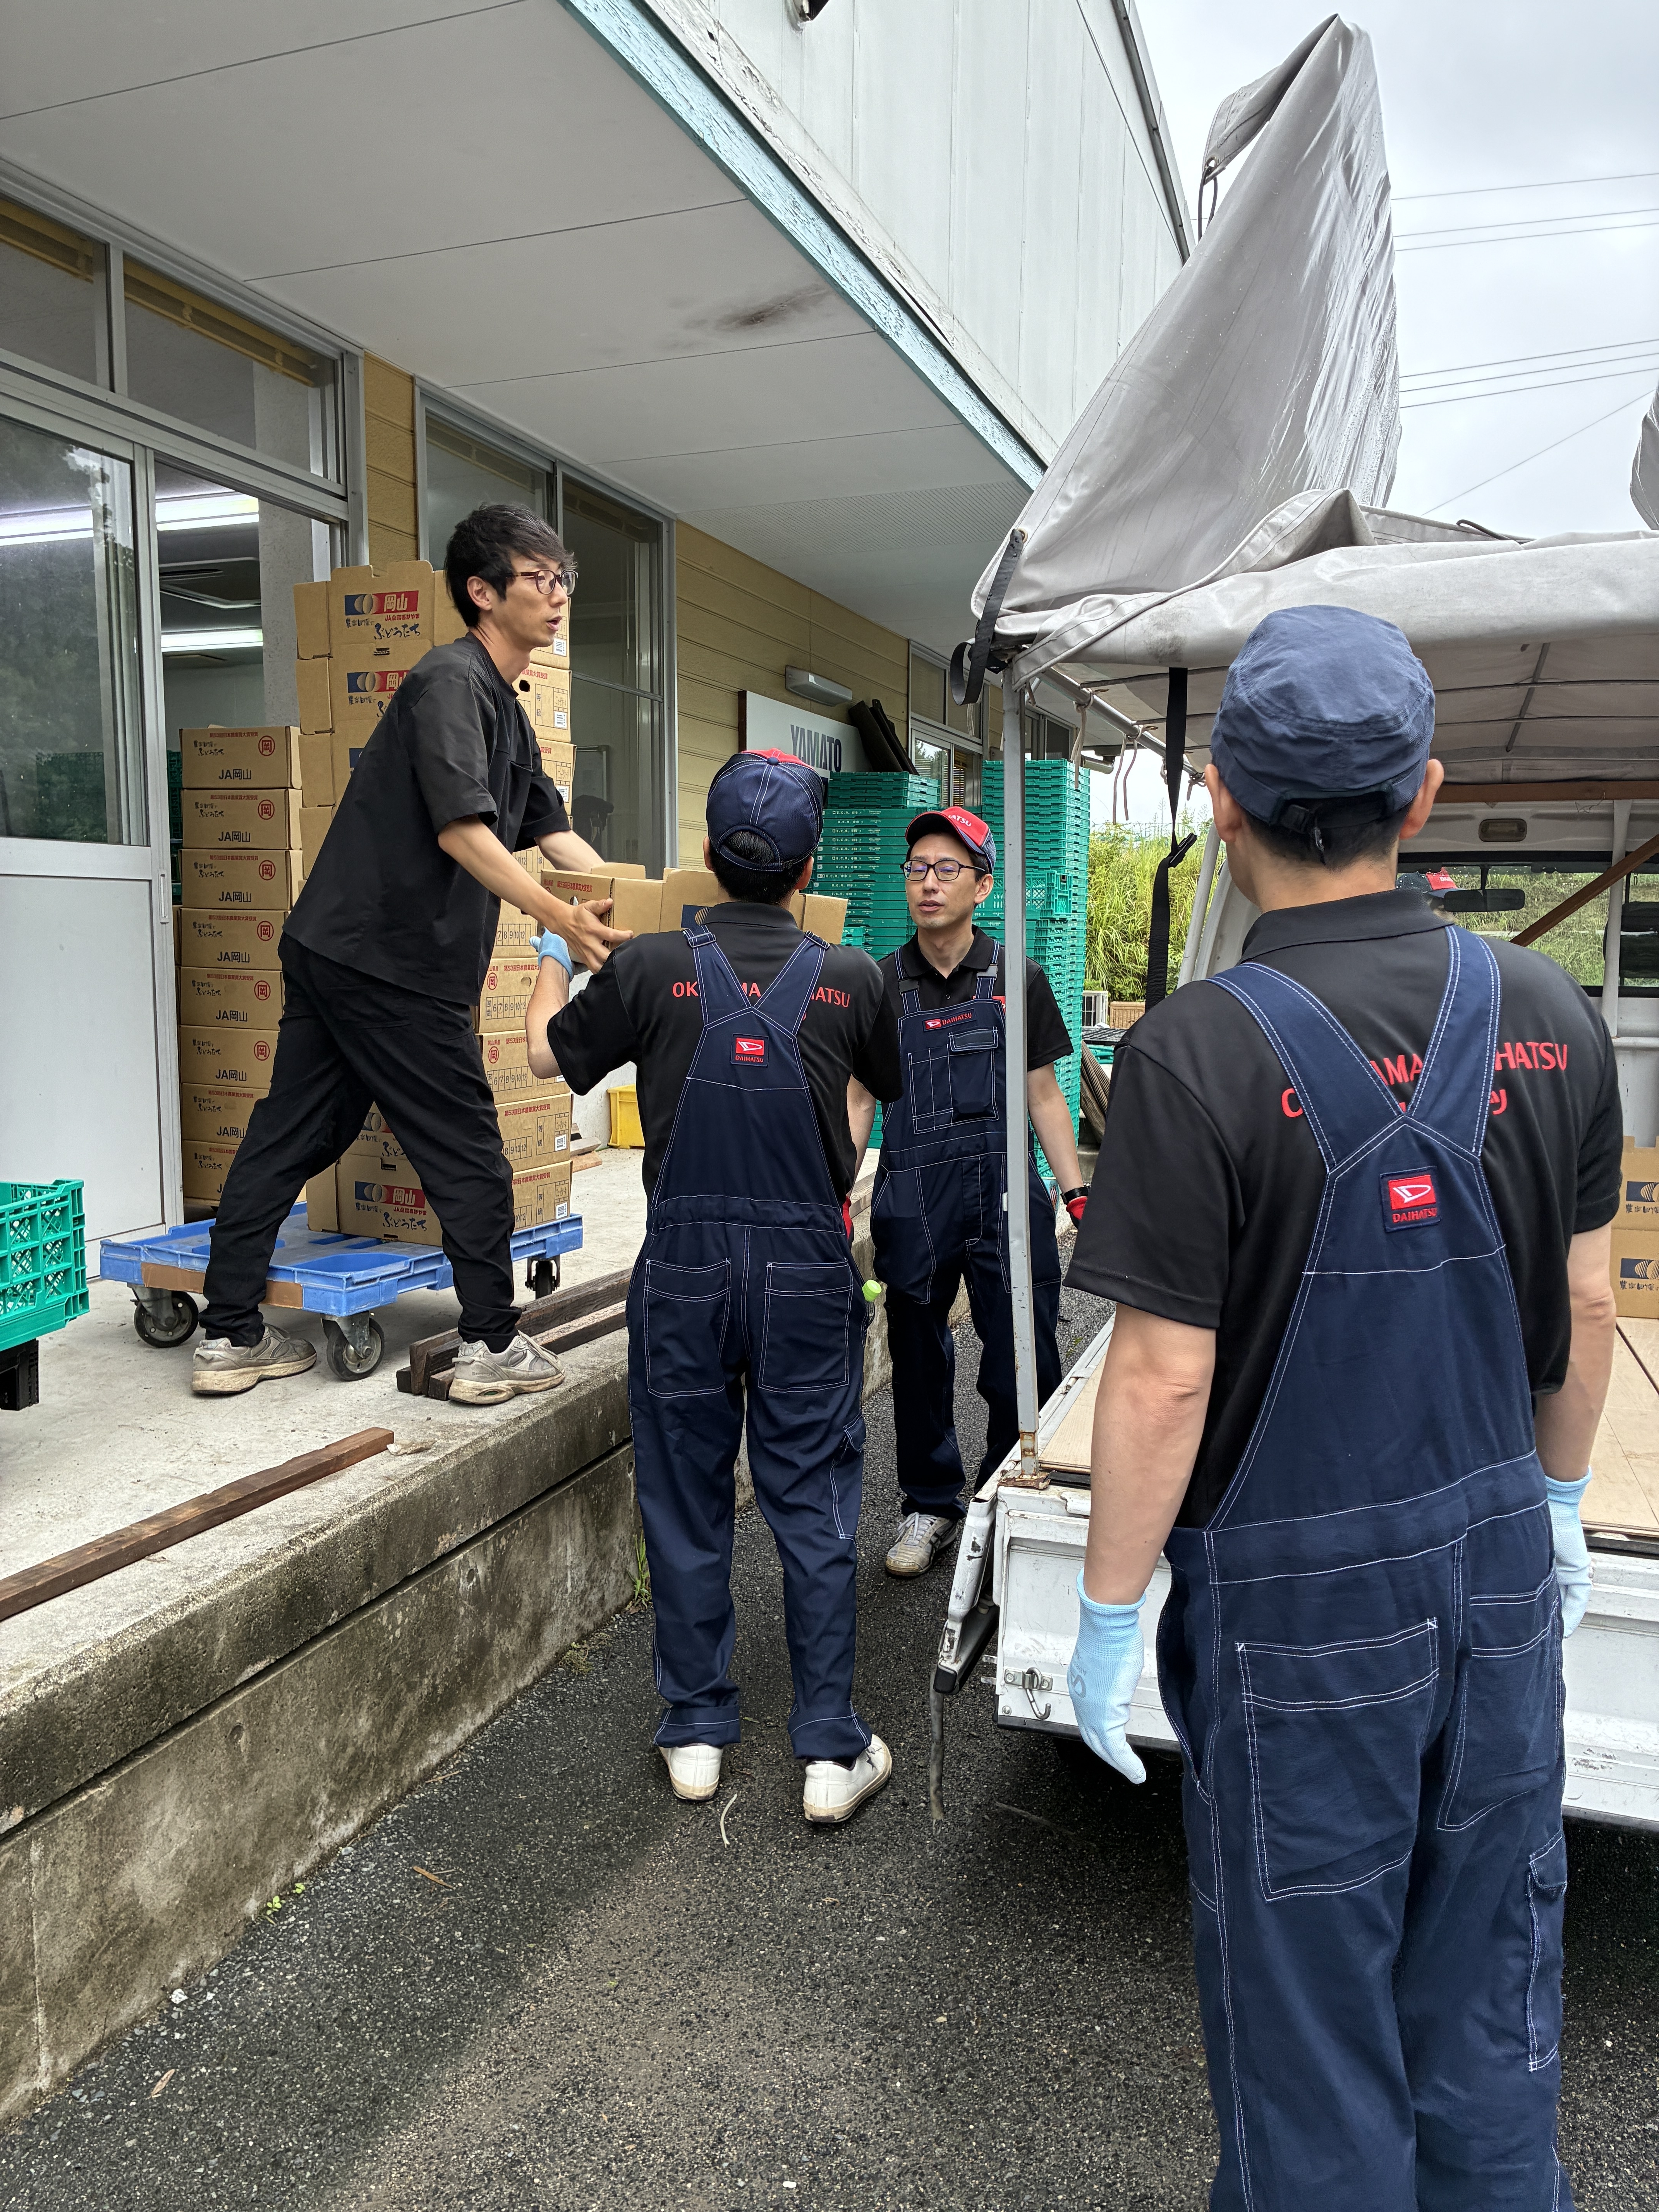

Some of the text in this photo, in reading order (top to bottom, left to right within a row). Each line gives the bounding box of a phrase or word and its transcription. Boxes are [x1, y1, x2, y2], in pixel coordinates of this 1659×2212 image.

[384, 593, 408, 612] 岡山
[374, 623, 421, 640] ぶどうたち
[790, 725, 842, 772] YAMATO
[218, 769, 252, 780] JA岡山
[948, 815, 972, 827] ATSU
[218, 831, 251, 842] JA岡山
[219, 891, 252, 902] JA岡山
[504, 931, 507, 939] 8
[510, 931, 513, 939] 9
[217, 951, 250, 963] JA岡山
[811, 987, 850, 1008] ATSU
[493, 1004, 496, 1012] 6
[498, 1003, 502, 1012] 7
[215, 1010, 248, 1022] JA岡山
[941, 1012, 972, 1026] DAIHATSU
[1494, 1042, 1567, 1071] HATSU
[215, 1069, 247, 1082] JA岡山
[500, 1076, 503, 1084] 7
[505, 1075, 509, 1084] 8
[511, 1075, 515, 1083] 9
[516, 1145, 520, 1154] 10
[521, 1144, 526, 1152] 12
[393, 1188, 416, 1206] 岡山
[521, 1213, 526, 1221] 12
[1392, 1207, 1437, 1223] DAIHATSU
[383, 1212, 427, 1231] ぶどうたち
